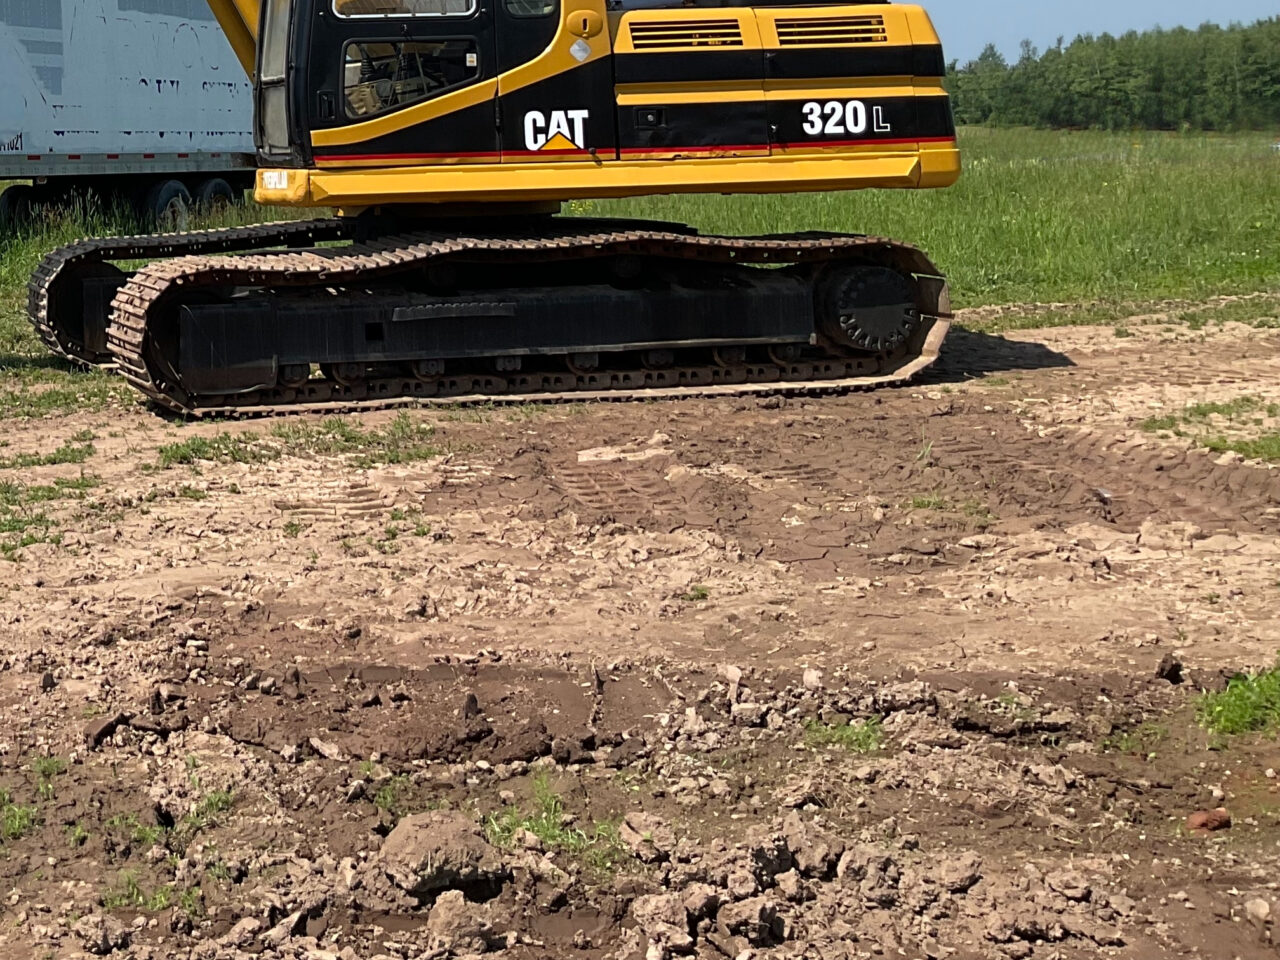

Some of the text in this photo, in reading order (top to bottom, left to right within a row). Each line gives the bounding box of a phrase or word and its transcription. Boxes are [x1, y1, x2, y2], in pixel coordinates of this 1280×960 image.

[524, 109, 589, 151] CAT
[802, 100, 890, 135] 320 L
